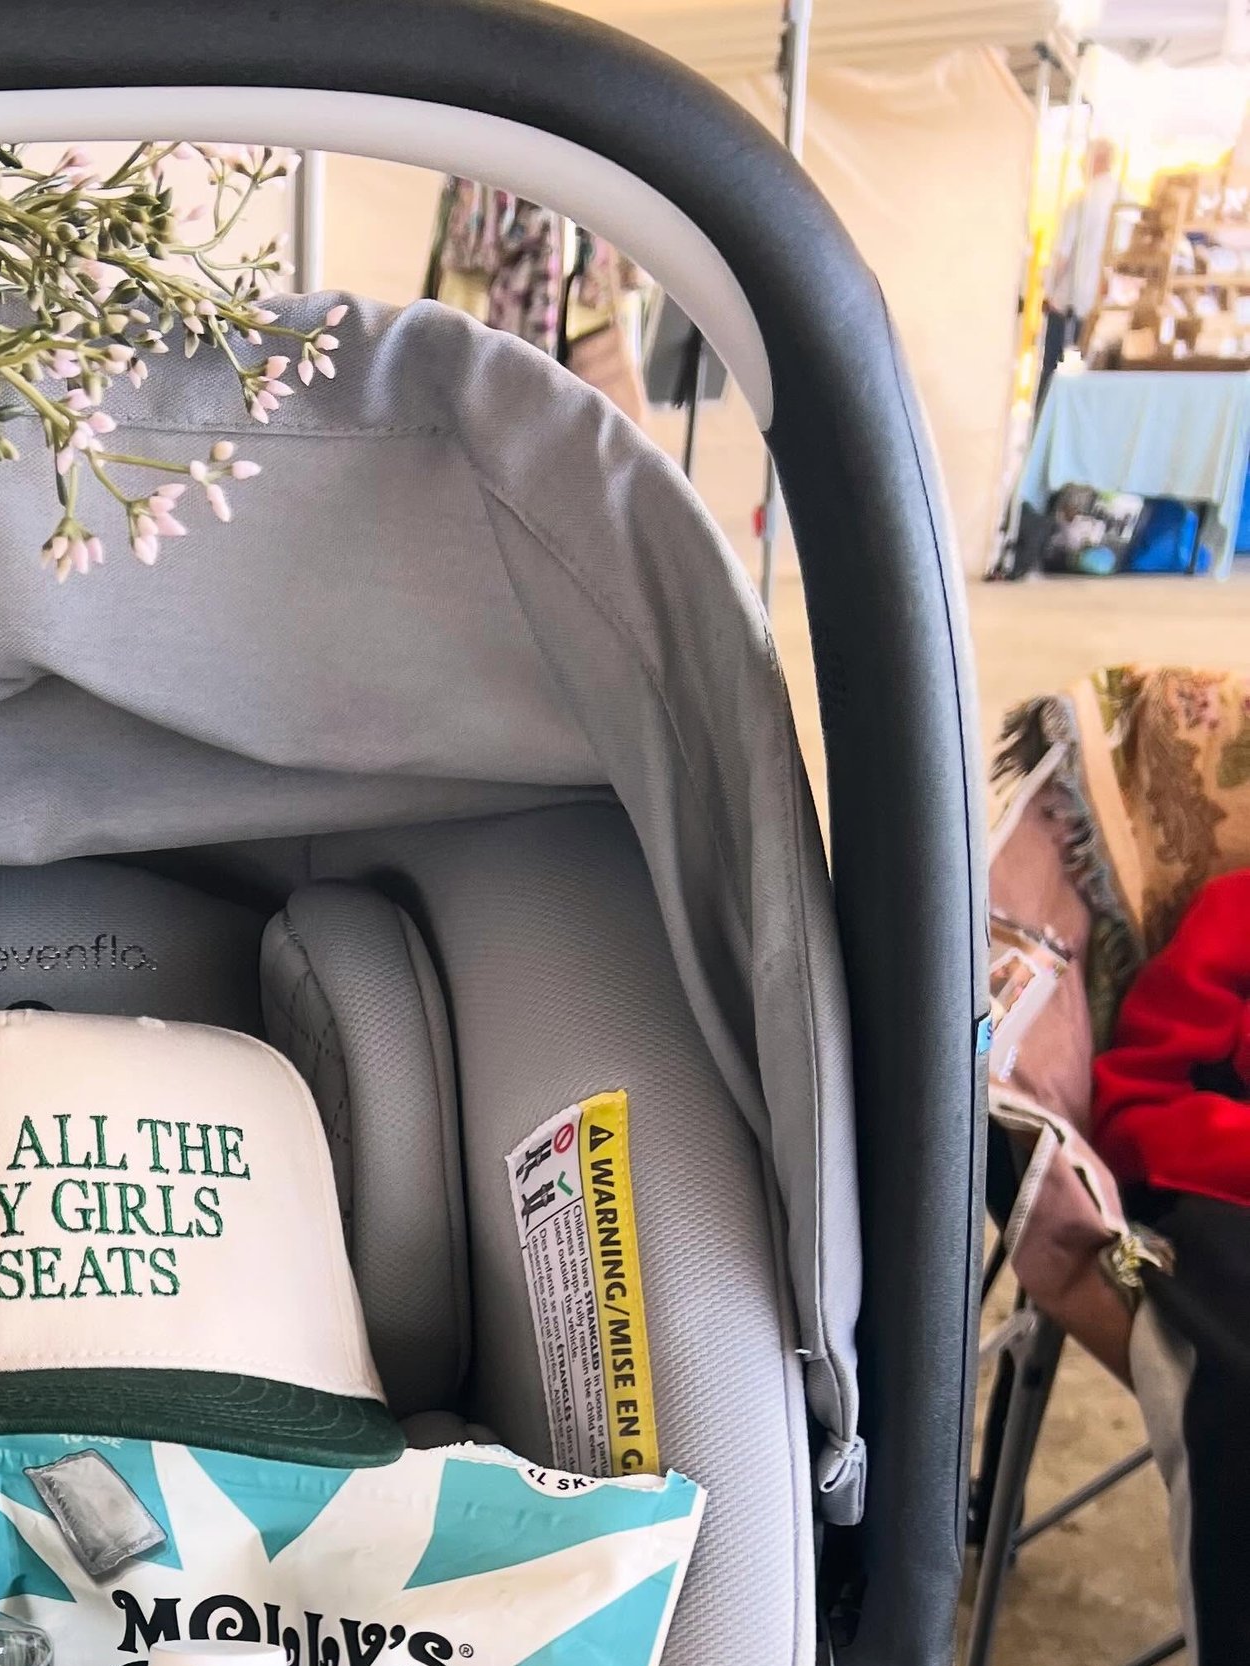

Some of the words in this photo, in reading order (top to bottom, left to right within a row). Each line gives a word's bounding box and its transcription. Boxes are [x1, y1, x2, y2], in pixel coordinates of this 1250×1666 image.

[7, 1114, 128, 1171] ALL
[137, 1118, 250, 1180] THE
[52, 1178, 223, 1238] GIRLS
[540, 1228, 548, 1251] Des
[553, 1217, 565, 1246] used
[563, 1210, 576, 1257] harness
[574, 1205, 586, 1256] Children
[544, 1254, 555, 1297] enfants
[558, 1249, 571, 1292] outside
[580, 1258, 590, 1288] have
[551, 1301, 557, 1313] se
[565, 1294, 573, 1315] the
[575, 1299, 584, 1327] Fully
[553, 1316, 562, 1342] sont
[584, 1290, 600, 1371] STRANGLED
[579, 1331, 589, 1375] restrain
[593, 1374, 600, 1387] in
[586, 1402, 596, 1431] child
[594, 1389, 602, 1421] loose
[616, 1399, 640, 1437] EN
[598, 1425, 605, 1437] or
[590, 1434, 598, 1463] even
